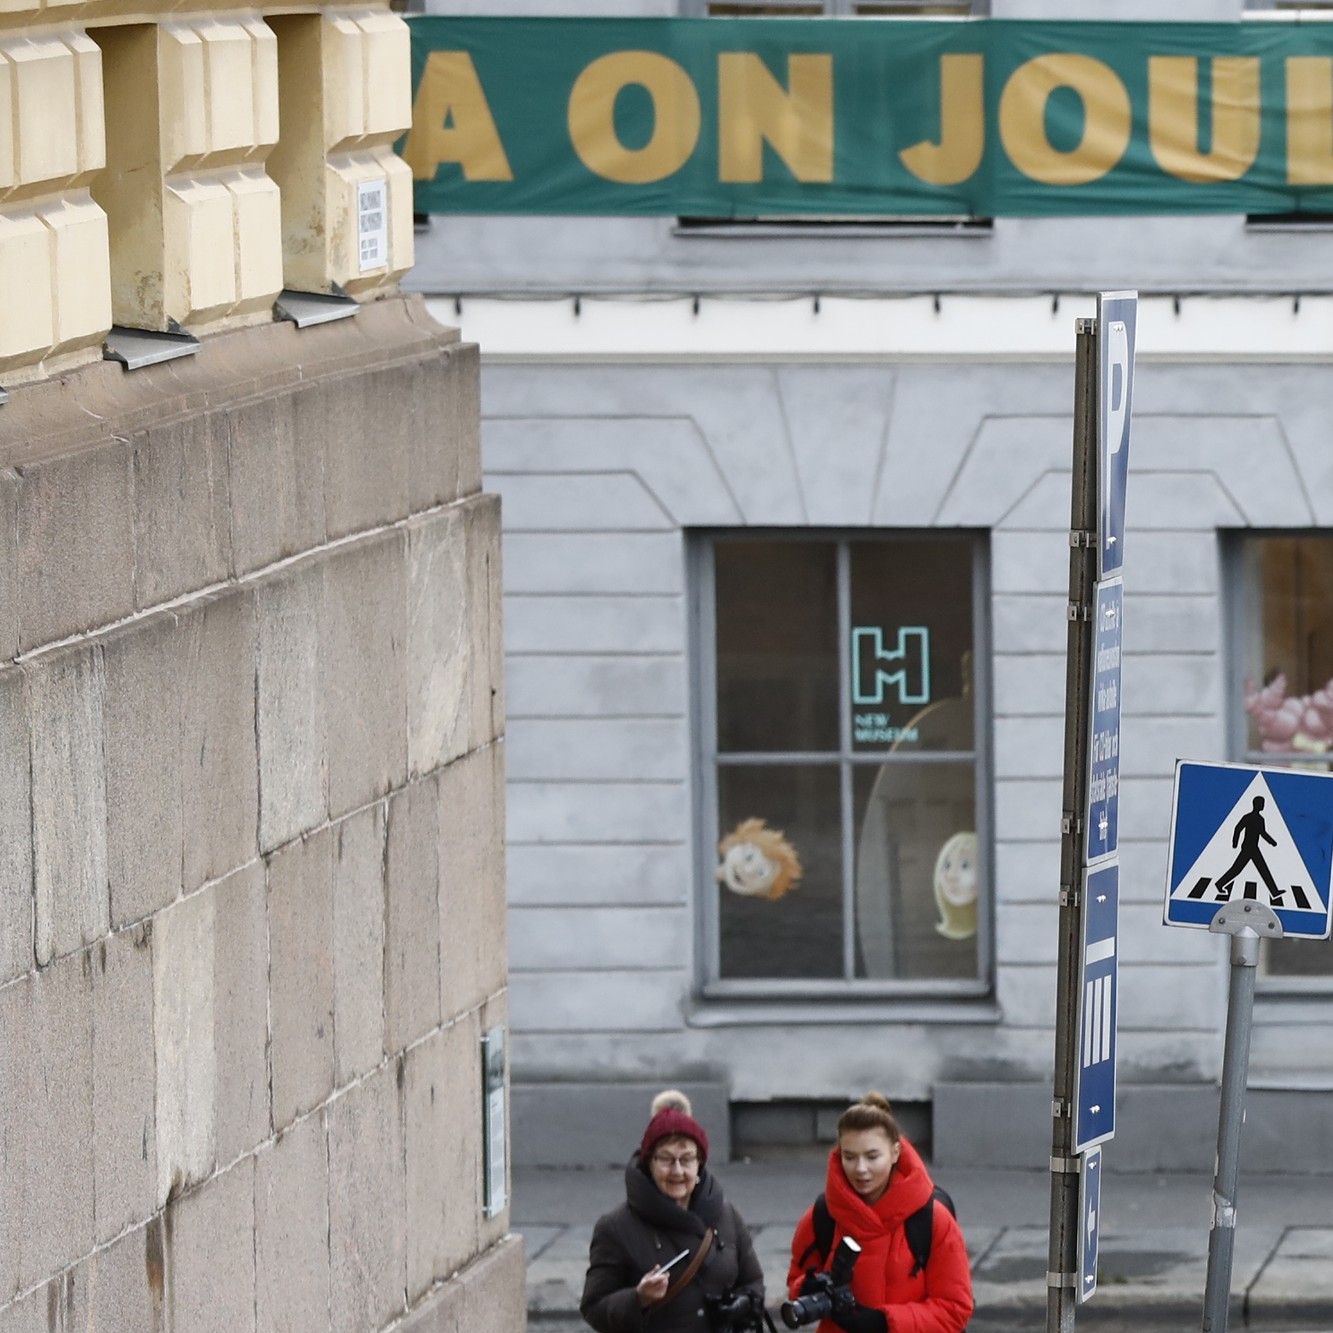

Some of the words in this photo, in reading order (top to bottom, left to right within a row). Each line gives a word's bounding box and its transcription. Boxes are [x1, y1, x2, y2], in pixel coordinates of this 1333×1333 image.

[568, 50, 833, 184] ON
[1105, 321, 1128, 550] P
[855, 712, 890, 728] NEW
[855, 727, 918, 742] MUSEUM
